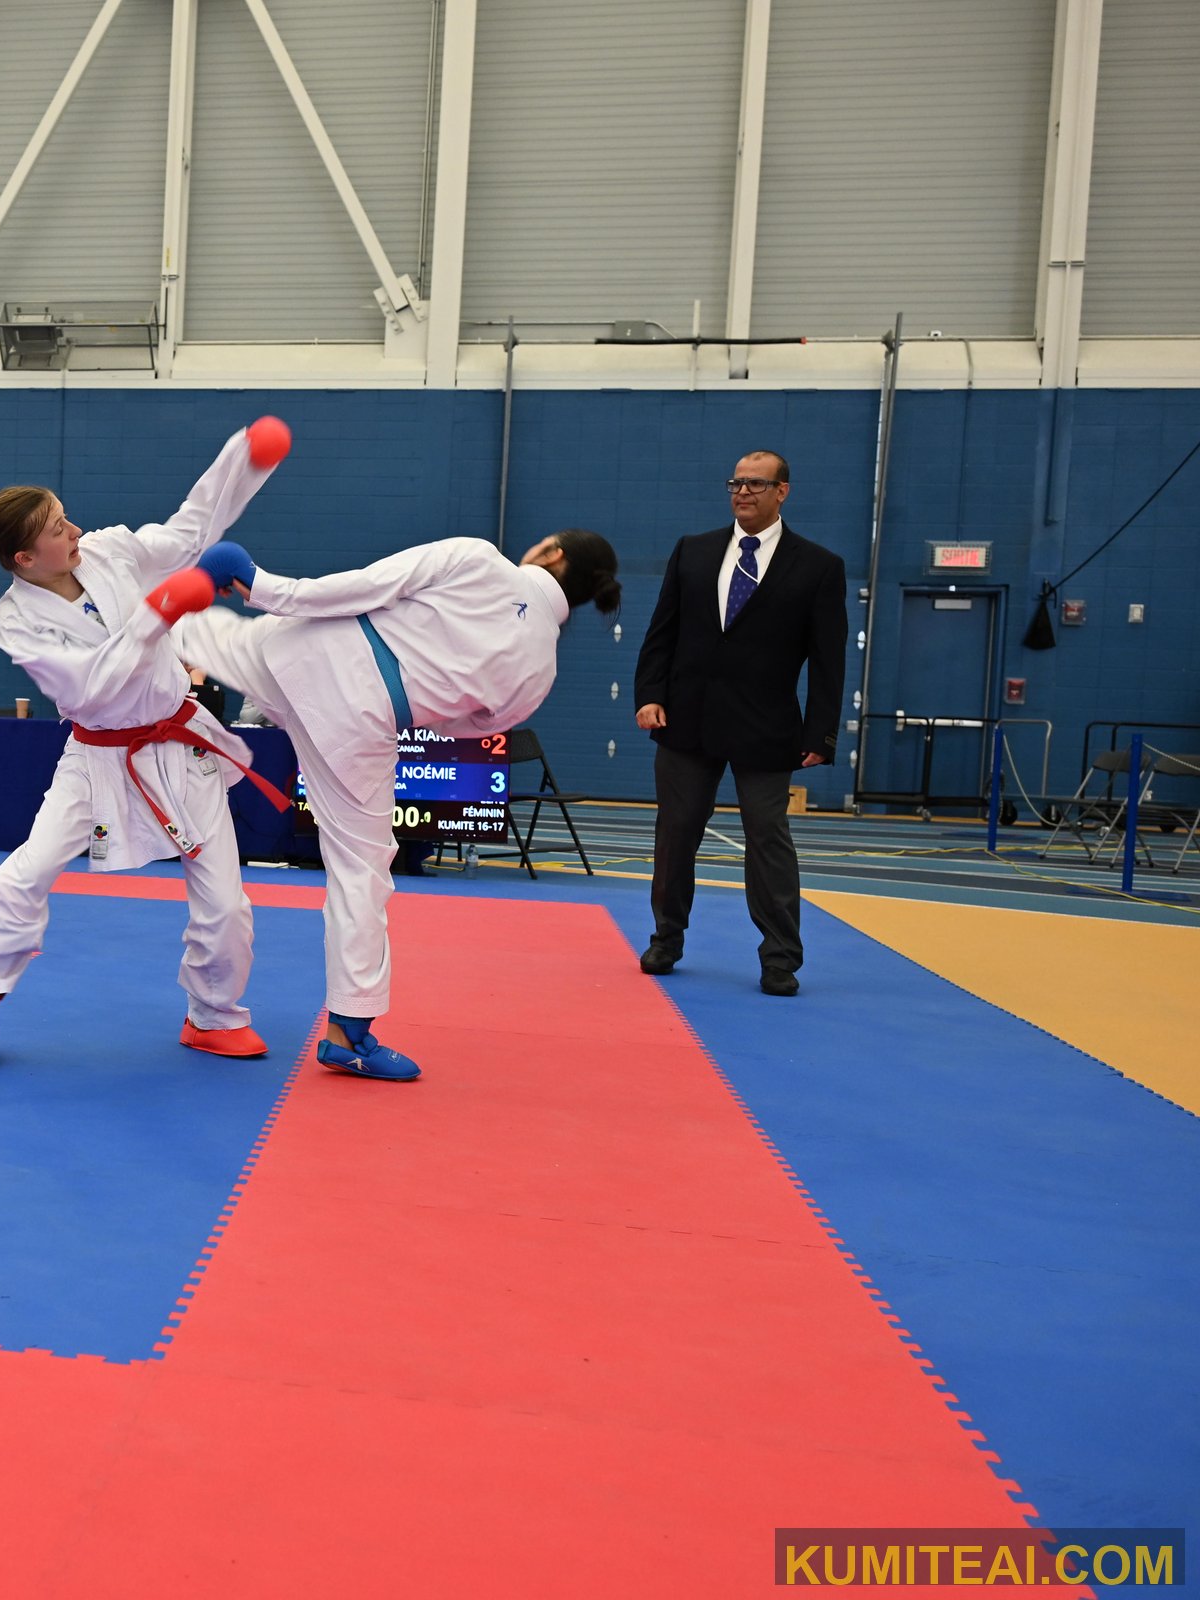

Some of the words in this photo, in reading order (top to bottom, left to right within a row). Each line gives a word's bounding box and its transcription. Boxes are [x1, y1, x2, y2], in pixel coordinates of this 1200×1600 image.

[402, 764, 456, 780] NOÉMIE
[490, 771, 506, 793] 3
[463, 806, 504, 818] FÉMININ
[438, 820, 474, 830] KUMITE
[477, 822, 504, 831] 16-17
